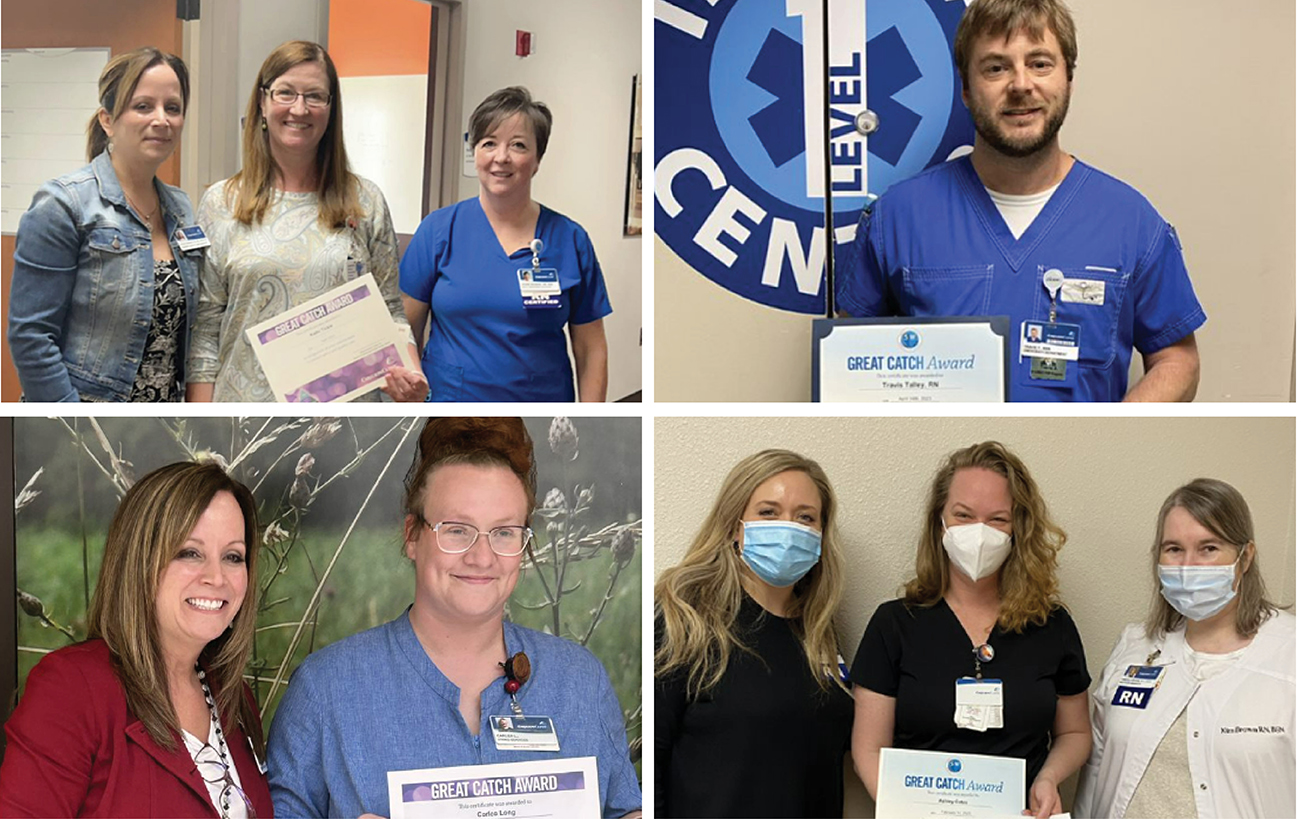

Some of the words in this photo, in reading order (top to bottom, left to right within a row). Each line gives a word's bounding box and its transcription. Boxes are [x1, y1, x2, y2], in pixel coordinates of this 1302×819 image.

[829, 52, 862, 193] LEVEL
[275, 318, 302, 336] GREAT
[300, 307, 326, 324] CATCH
[326, 294, 354, 313] AWARD
[848, 356, 884, 370] GREAT
[887, 356, 924, 370] CATCH
[926, 354, 975, 370] Award
[1119, 691, 1145, 705] RN
[431, 782, 470, 800] GREAT
[472, 779, 512, 797] CATCH
[514, 775, 558, 793] AWARD
[905, 775, 934, 788] GREAT
[936, 777, 965, 790] CATCH
[966, 781, 1004, 793] Award
